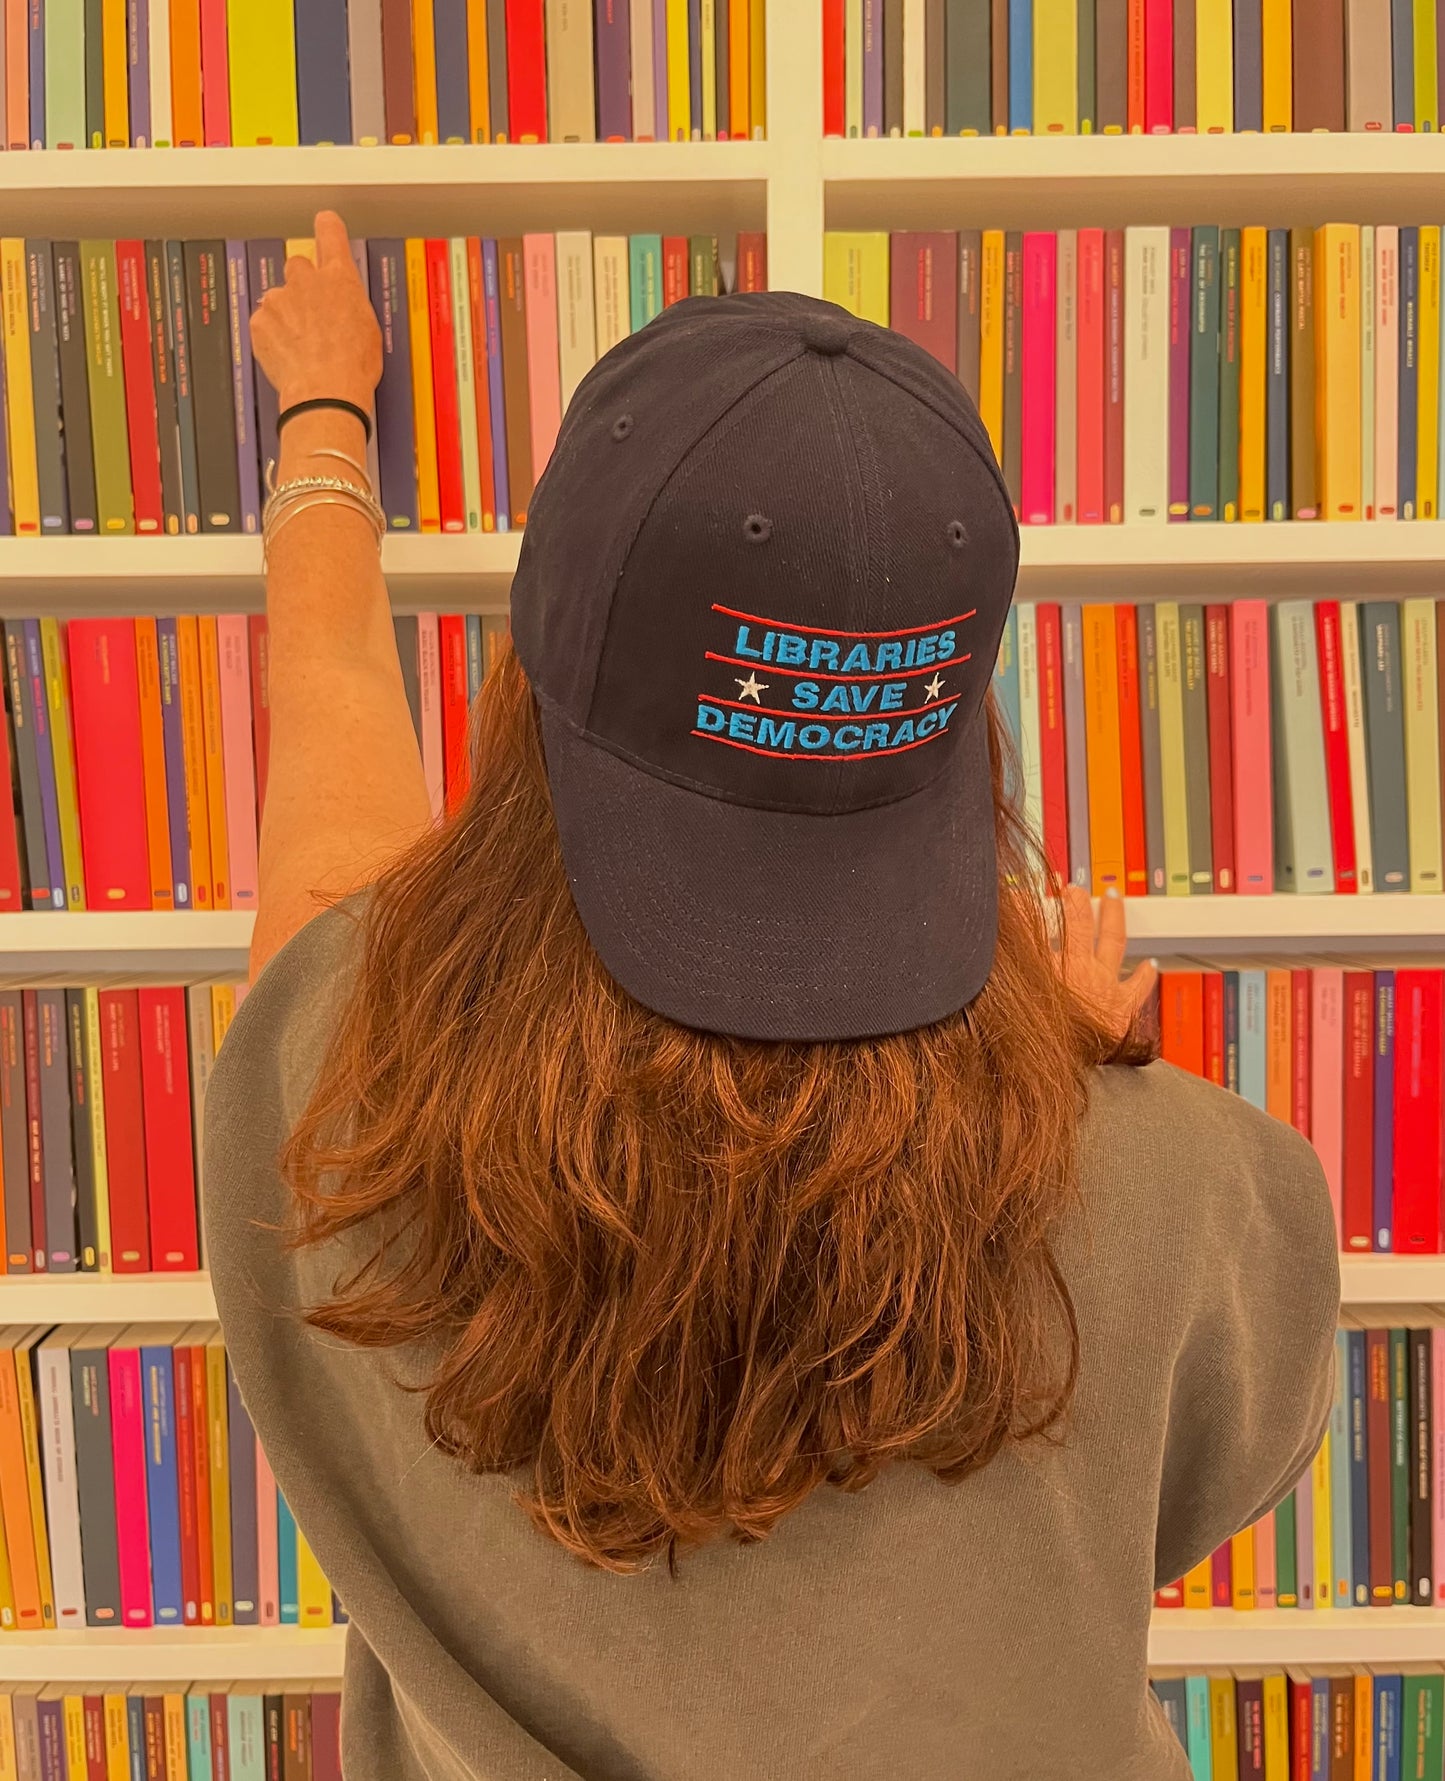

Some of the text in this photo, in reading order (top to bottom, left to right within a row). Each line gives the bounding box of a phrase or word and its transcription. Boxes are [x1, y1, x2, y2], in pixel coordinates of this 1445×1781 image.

[735, 625, 956, 672] LIBRARIES
[791, 682, 907, 712] SAVE
[696, 703, 958, 750] DEMOCRACY
